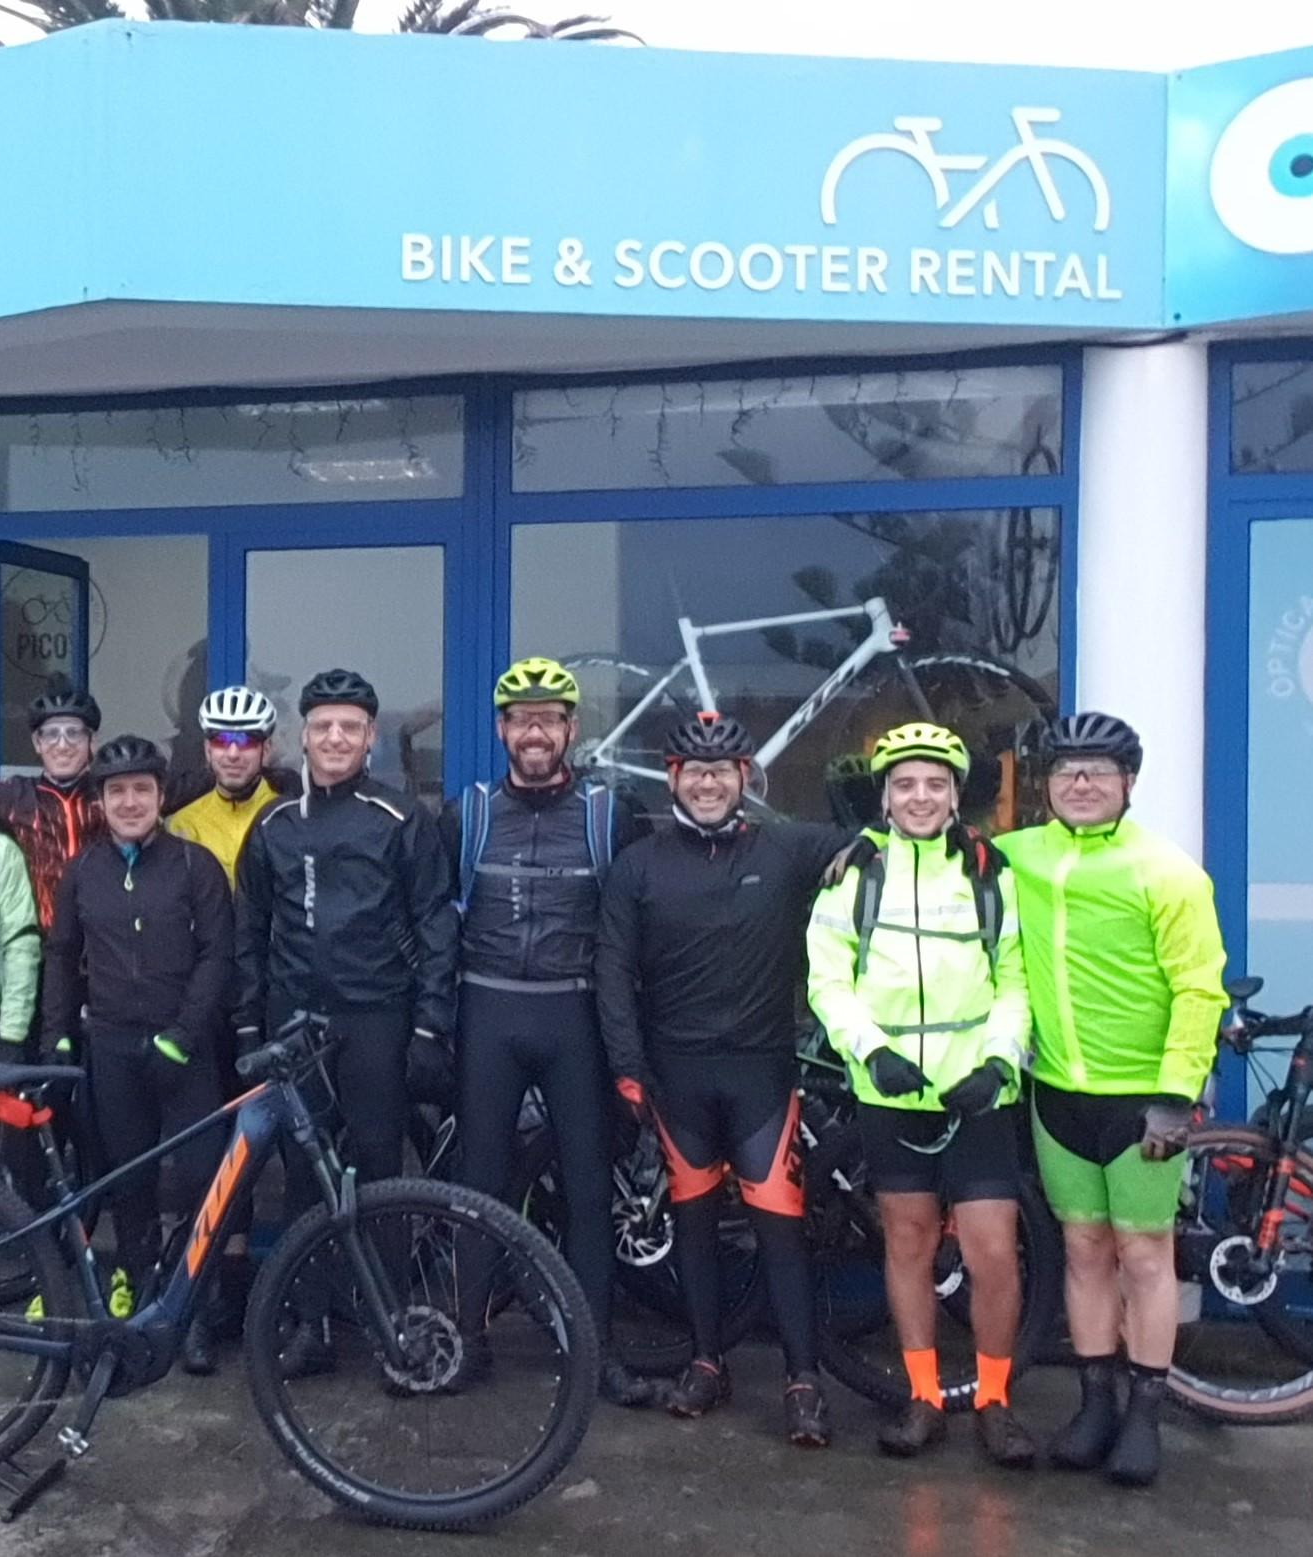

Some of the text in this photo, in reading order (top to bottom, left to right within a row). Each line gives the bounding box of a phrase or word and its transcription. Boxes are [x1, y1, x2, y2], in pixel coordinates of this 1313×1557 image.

[401, 233, 1123, 300] BIKE & SCOOTER RENTAL
[17, 633, 67, 660] PICO
